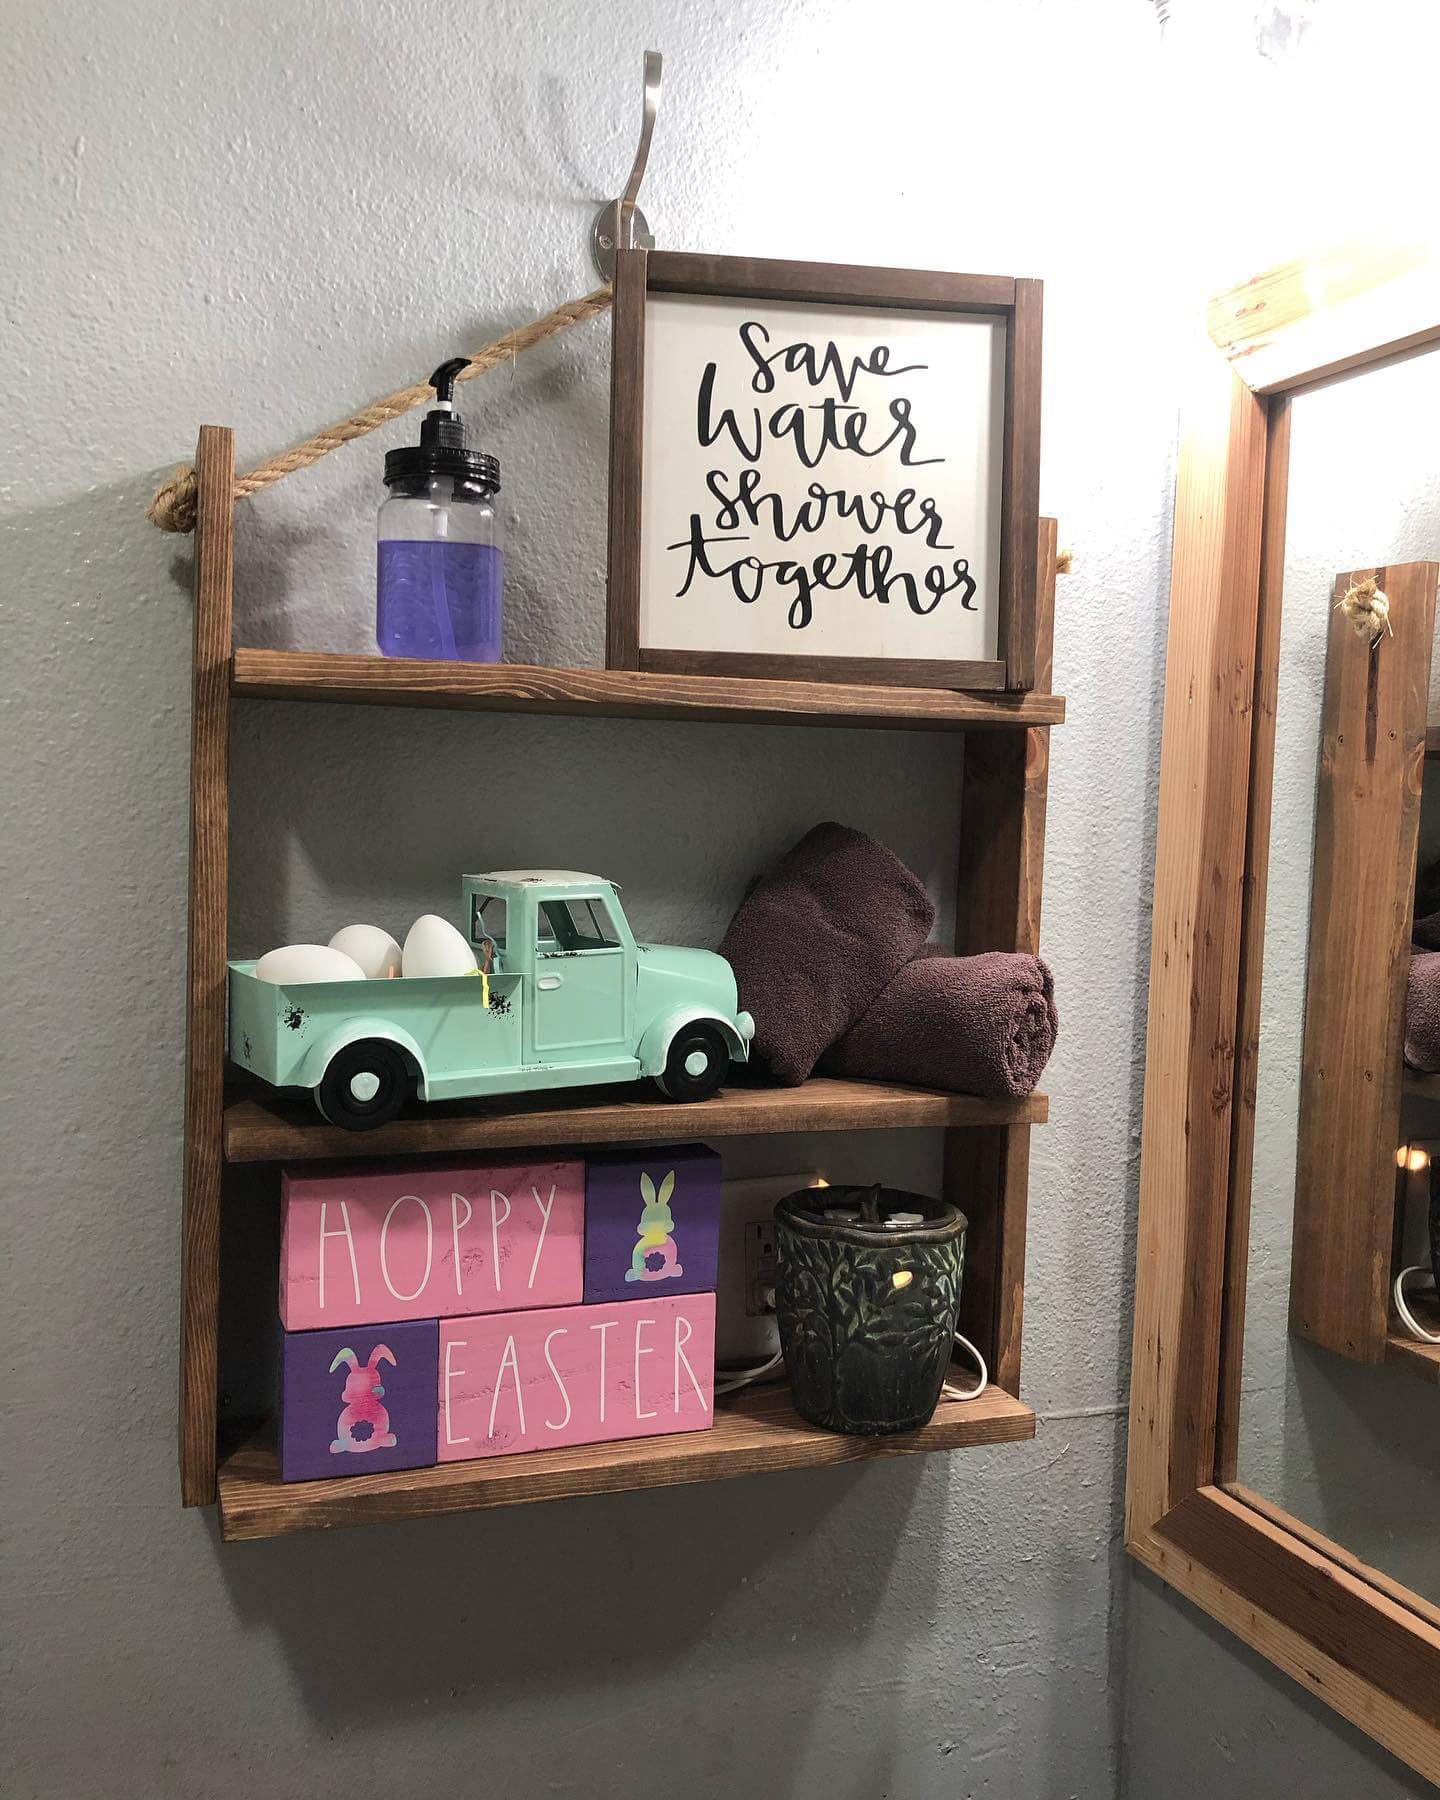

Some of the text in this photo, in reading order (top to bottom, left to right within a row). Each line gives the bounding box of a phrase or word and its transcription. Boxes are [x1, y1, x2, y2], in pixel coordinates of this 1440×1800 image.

[667, 513, 978, 630] together
[319, 1185, 557, 1309] HOPPY
[444, 1316, 709, 1445] EASTER
